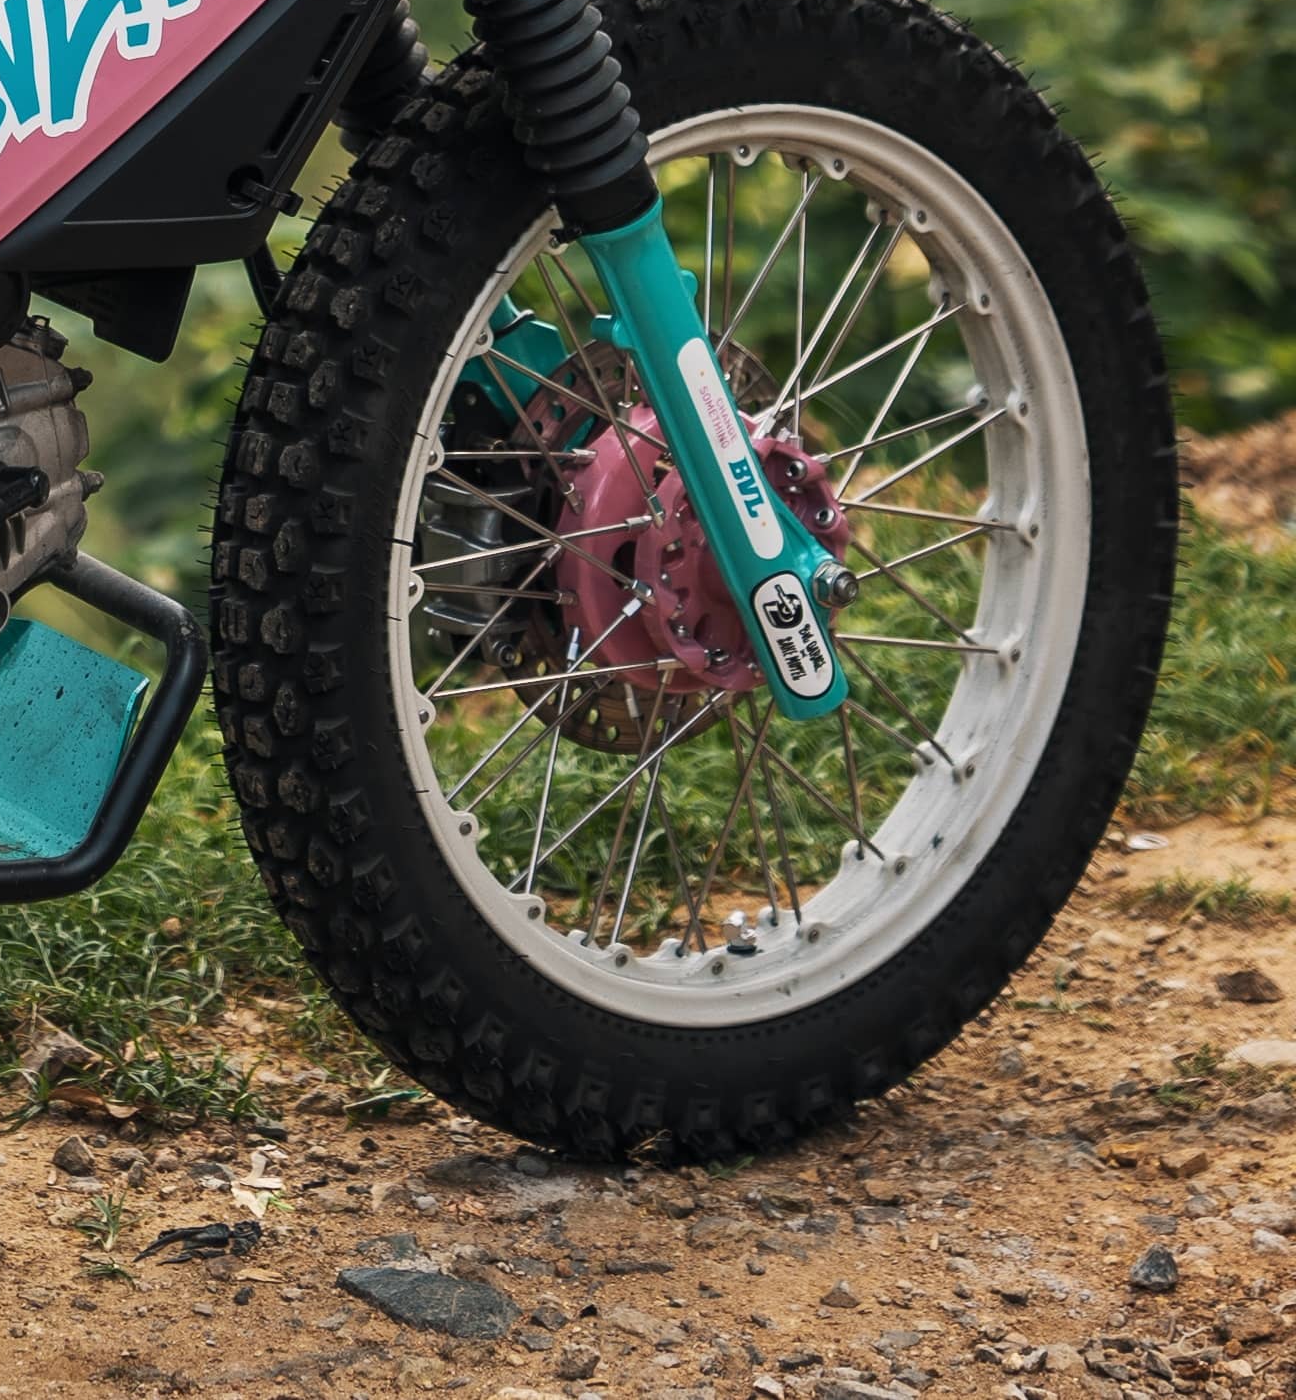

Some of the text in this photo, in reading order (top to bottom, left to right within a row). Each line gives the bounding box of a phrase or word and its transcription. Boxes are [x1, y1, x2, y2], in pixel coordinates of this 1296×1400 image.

[699, 386, 729, 449] SOMETHING
[716, 397, 738, 442] CHANGE
[728, 457, 764, 518] BVL
